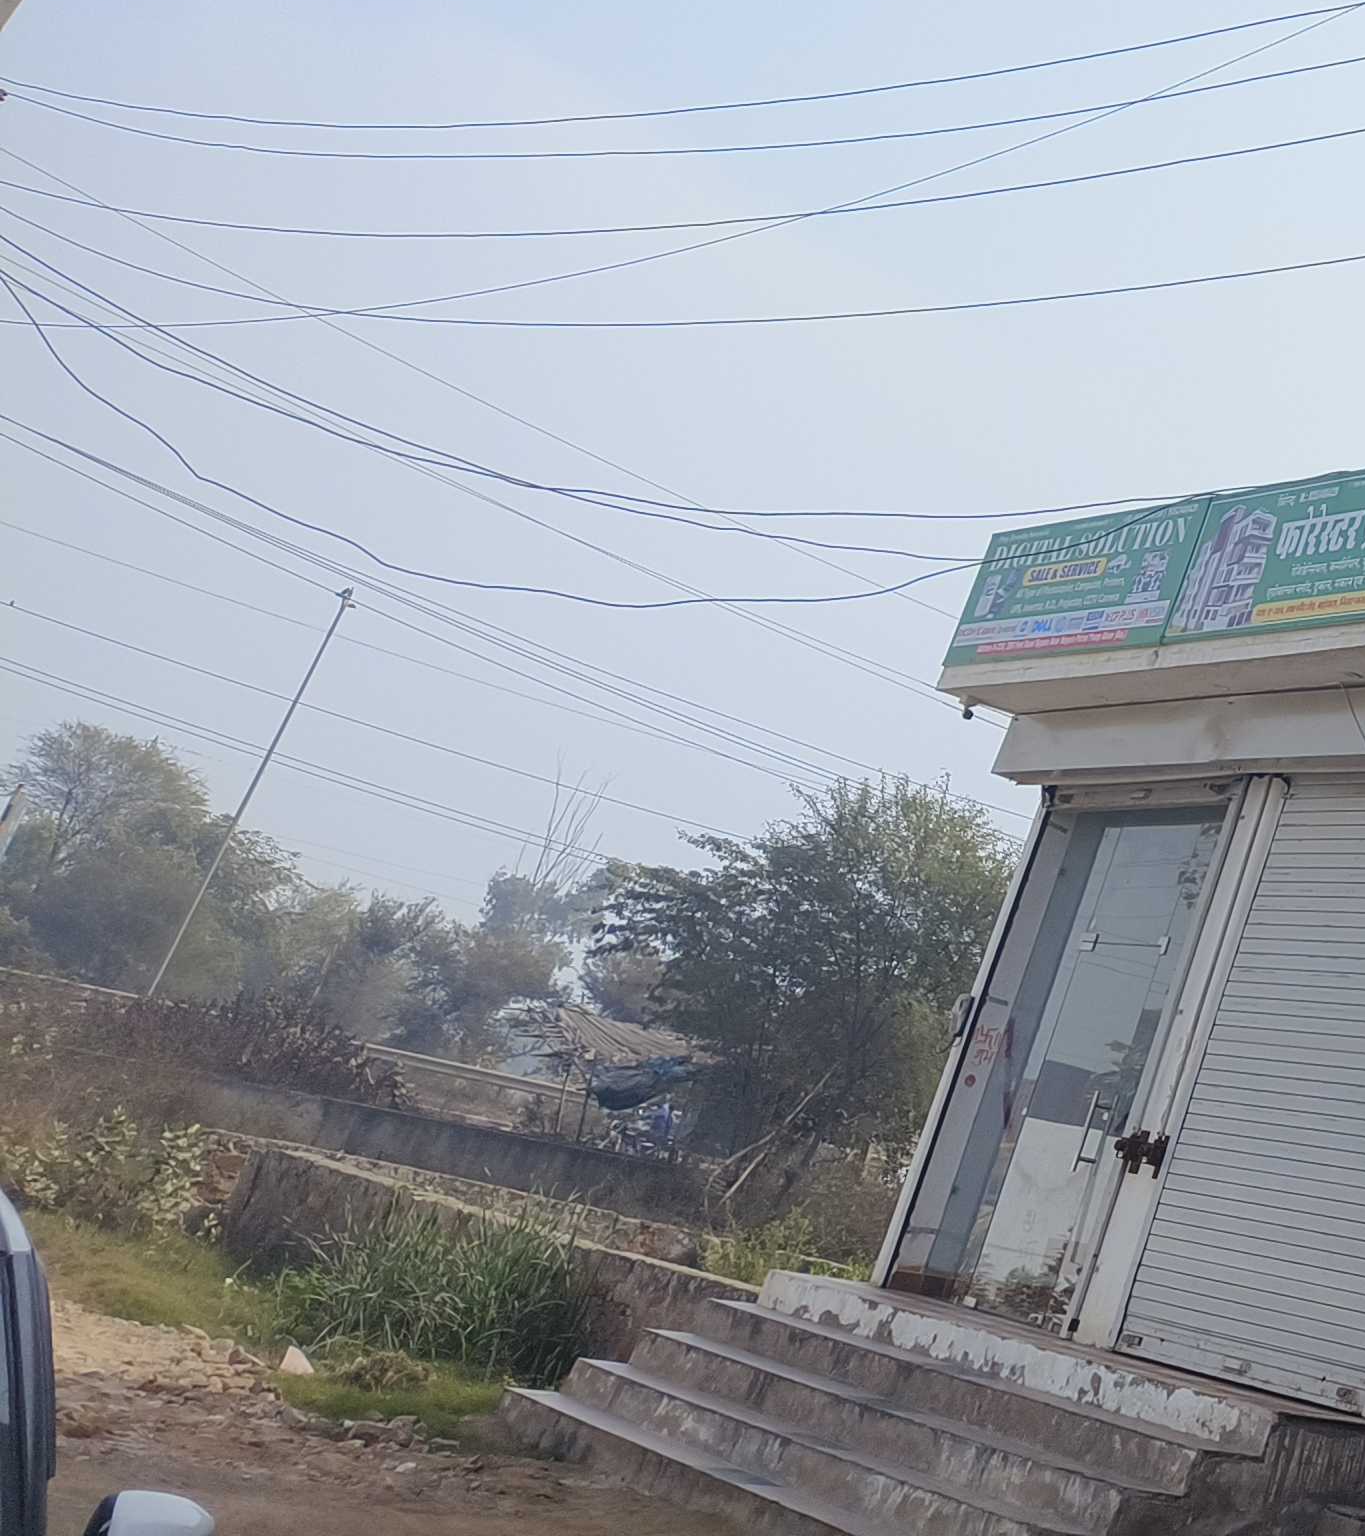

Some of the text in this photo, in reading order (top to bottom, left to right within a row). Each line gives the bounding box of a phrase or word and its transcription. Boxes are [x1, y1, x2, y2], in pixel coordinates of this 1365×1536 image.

[991, 535, 1077, 571] DIGITAL
[1075, 516, 1192, 559] SOLUTION
[1028, 567, 1053, 583] SALE
